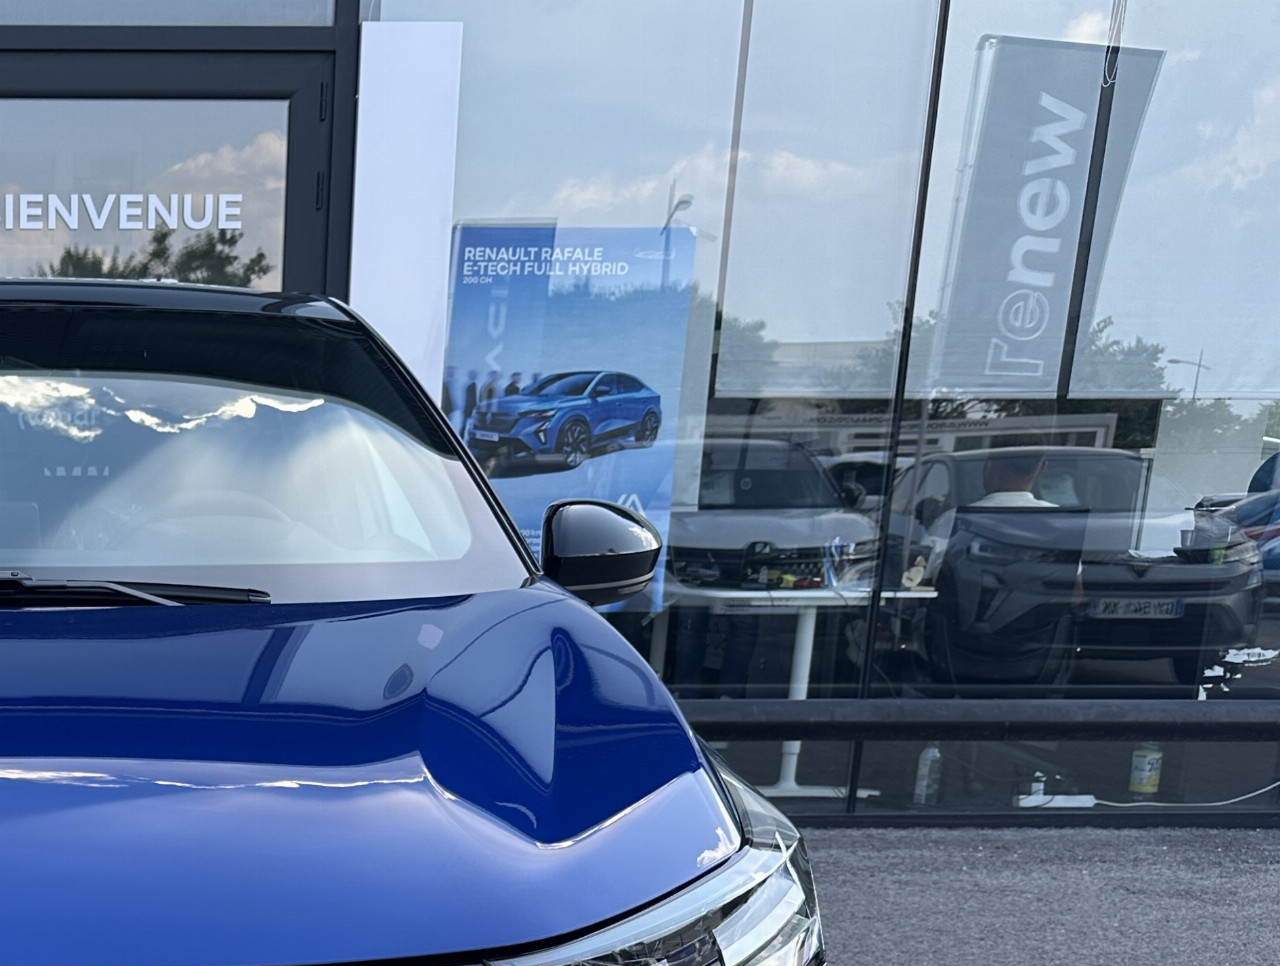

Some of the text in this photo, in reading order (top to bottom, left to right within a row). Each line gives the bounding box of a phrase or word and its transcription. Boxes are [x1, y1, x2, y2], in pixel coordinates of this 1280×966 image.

[984, 91, 1087, 377] renew
[464, 248, 603, 261] RENAULT RAFALE
[463, 262, 629, 275] E-TECH FULL HYBRID
[462, 276, 478, 284] 200
